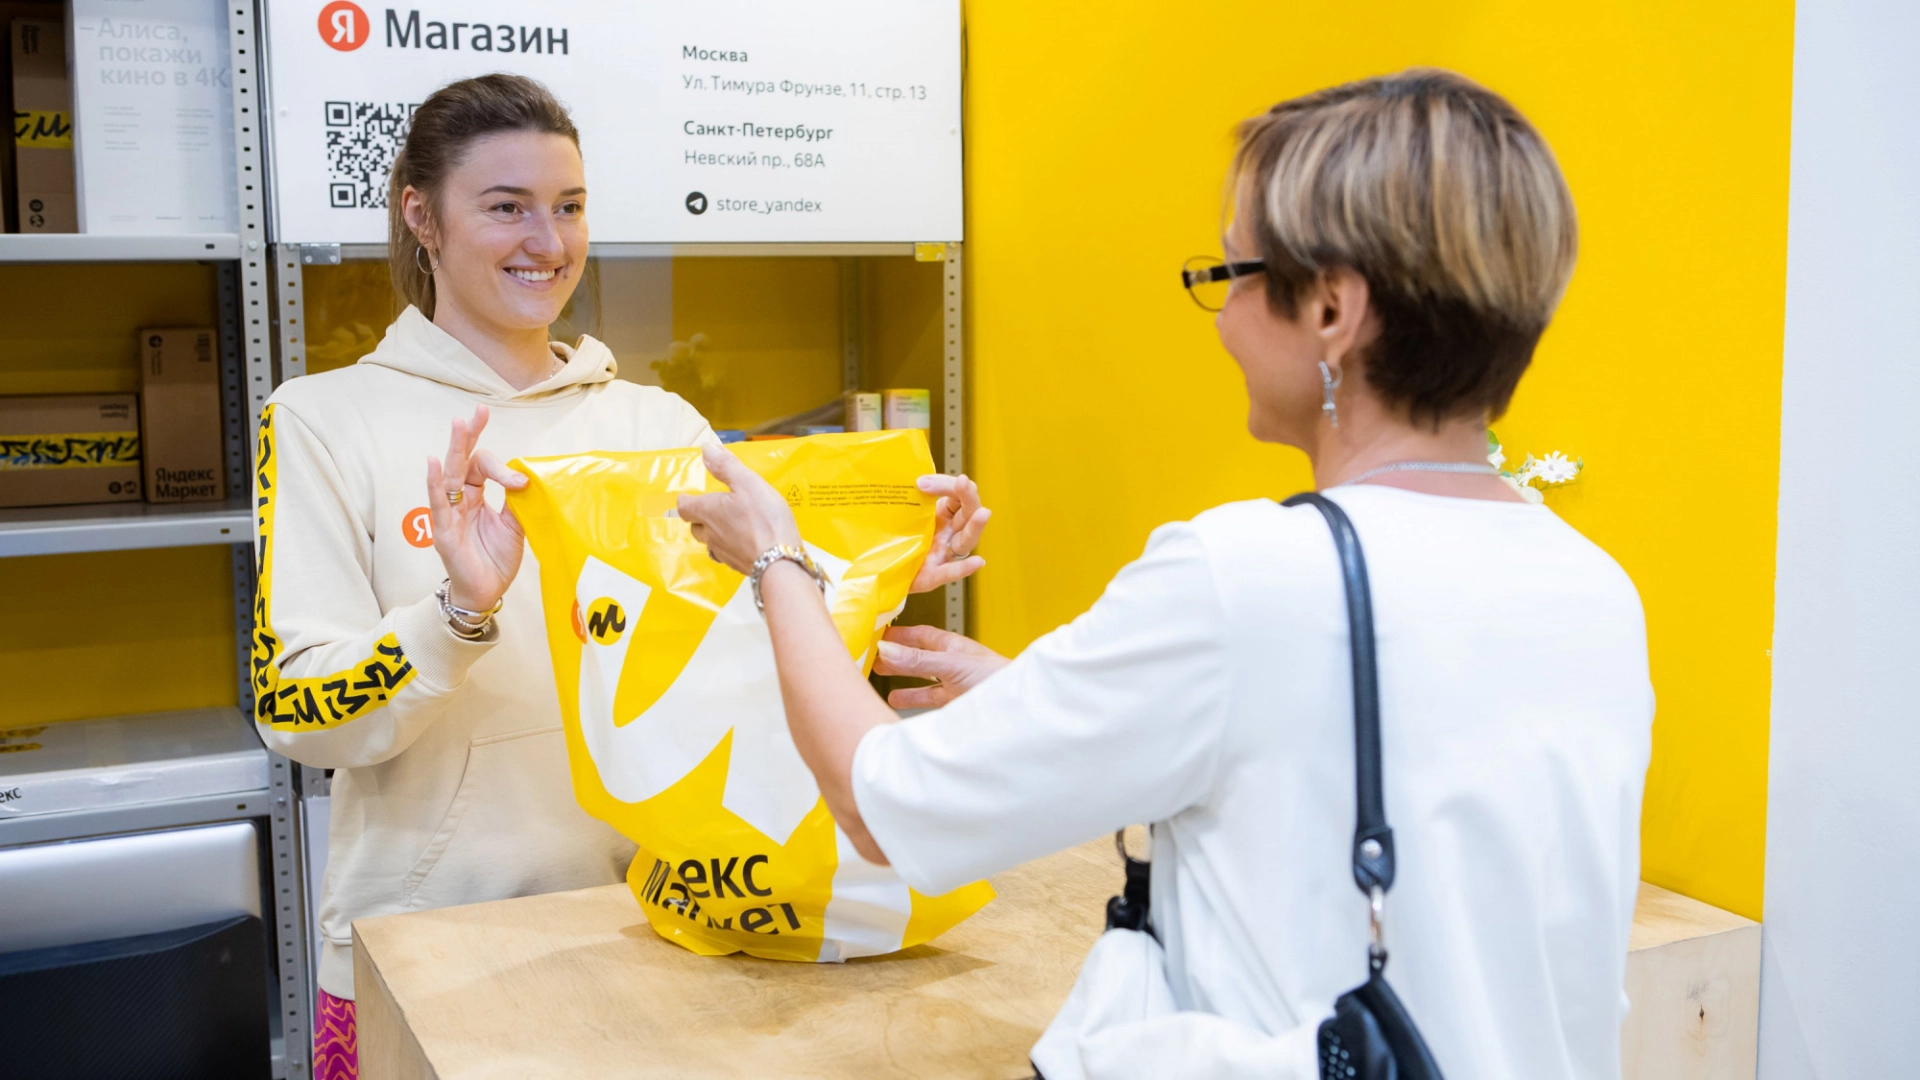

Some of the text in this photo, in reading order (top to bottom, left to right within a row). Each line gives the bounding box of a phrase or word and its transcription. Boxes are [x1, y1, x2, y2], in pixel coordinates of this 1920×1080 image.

[98, 17, 189, 44] Алиса,
[331, 9, 569, 55] Я Магазин
[99, 45, 203, 64] покажи
[682, 45, 748, 62] Москва
[100, 69, 167, 86] кино
[174, 74, 188, 87] в
[682, 74, 927, 101] Ул. Тимура Фрунзе, 11, стр. 13
[683, 121, 834, 143] Санкт-Петербург
[684, 150, 826, 170] Невский пр., 68А
[716, 198, 823, 214] store_yandex
[155, 468, 215, 484] Яндекс
[155, 484, 217, 499] Маркет
[412, 514, 433, 542] Я
